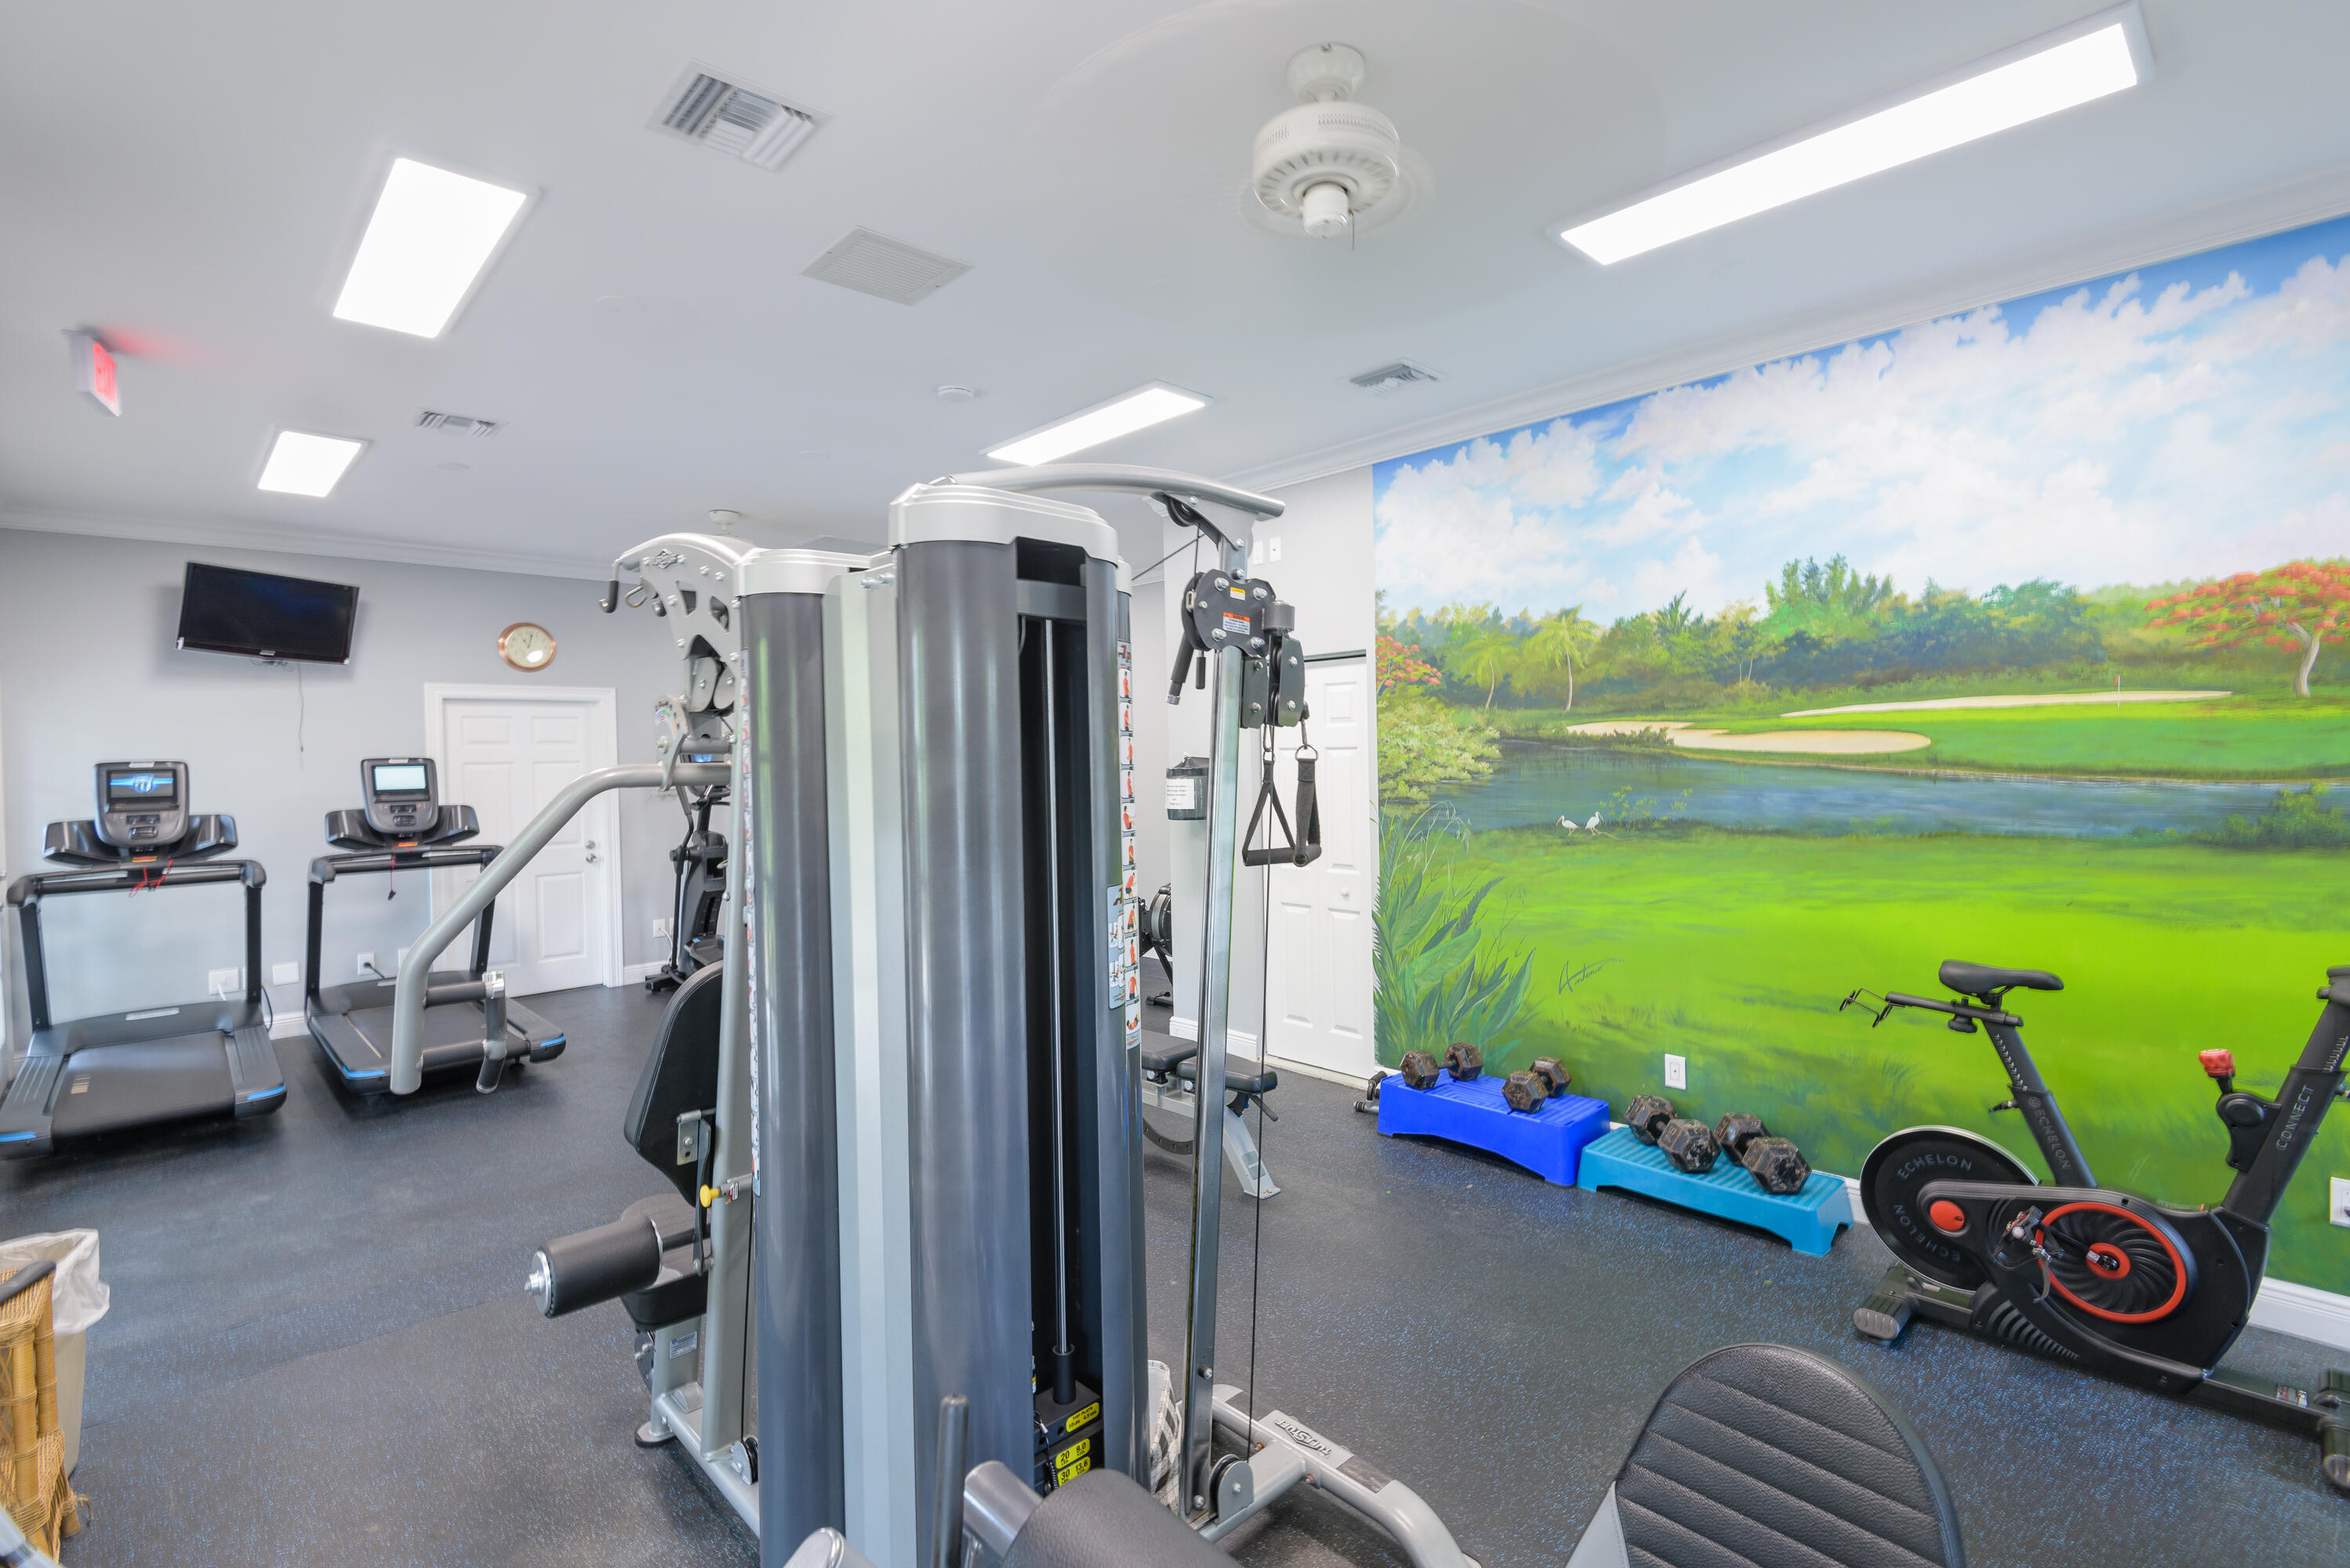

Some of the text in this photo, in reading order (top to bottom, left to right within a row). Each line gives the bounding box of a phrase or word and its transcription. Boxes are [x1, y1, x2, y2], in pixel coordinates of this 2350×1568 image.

[2276, 1084, 2315, 1149] CONNECT
[2035, 1109, 2072, 1169] ECHELON
[1897, 1153, 1973, 1179] ECHELON
[1894, 1204, 1961, 1261] ECHELON
[1081, 1406, 1094, 1416] PLATE
[1060, 1443, 1086, 1462] 20 9.0
[1061, 1459, 1088, 1481] 30 13.6
